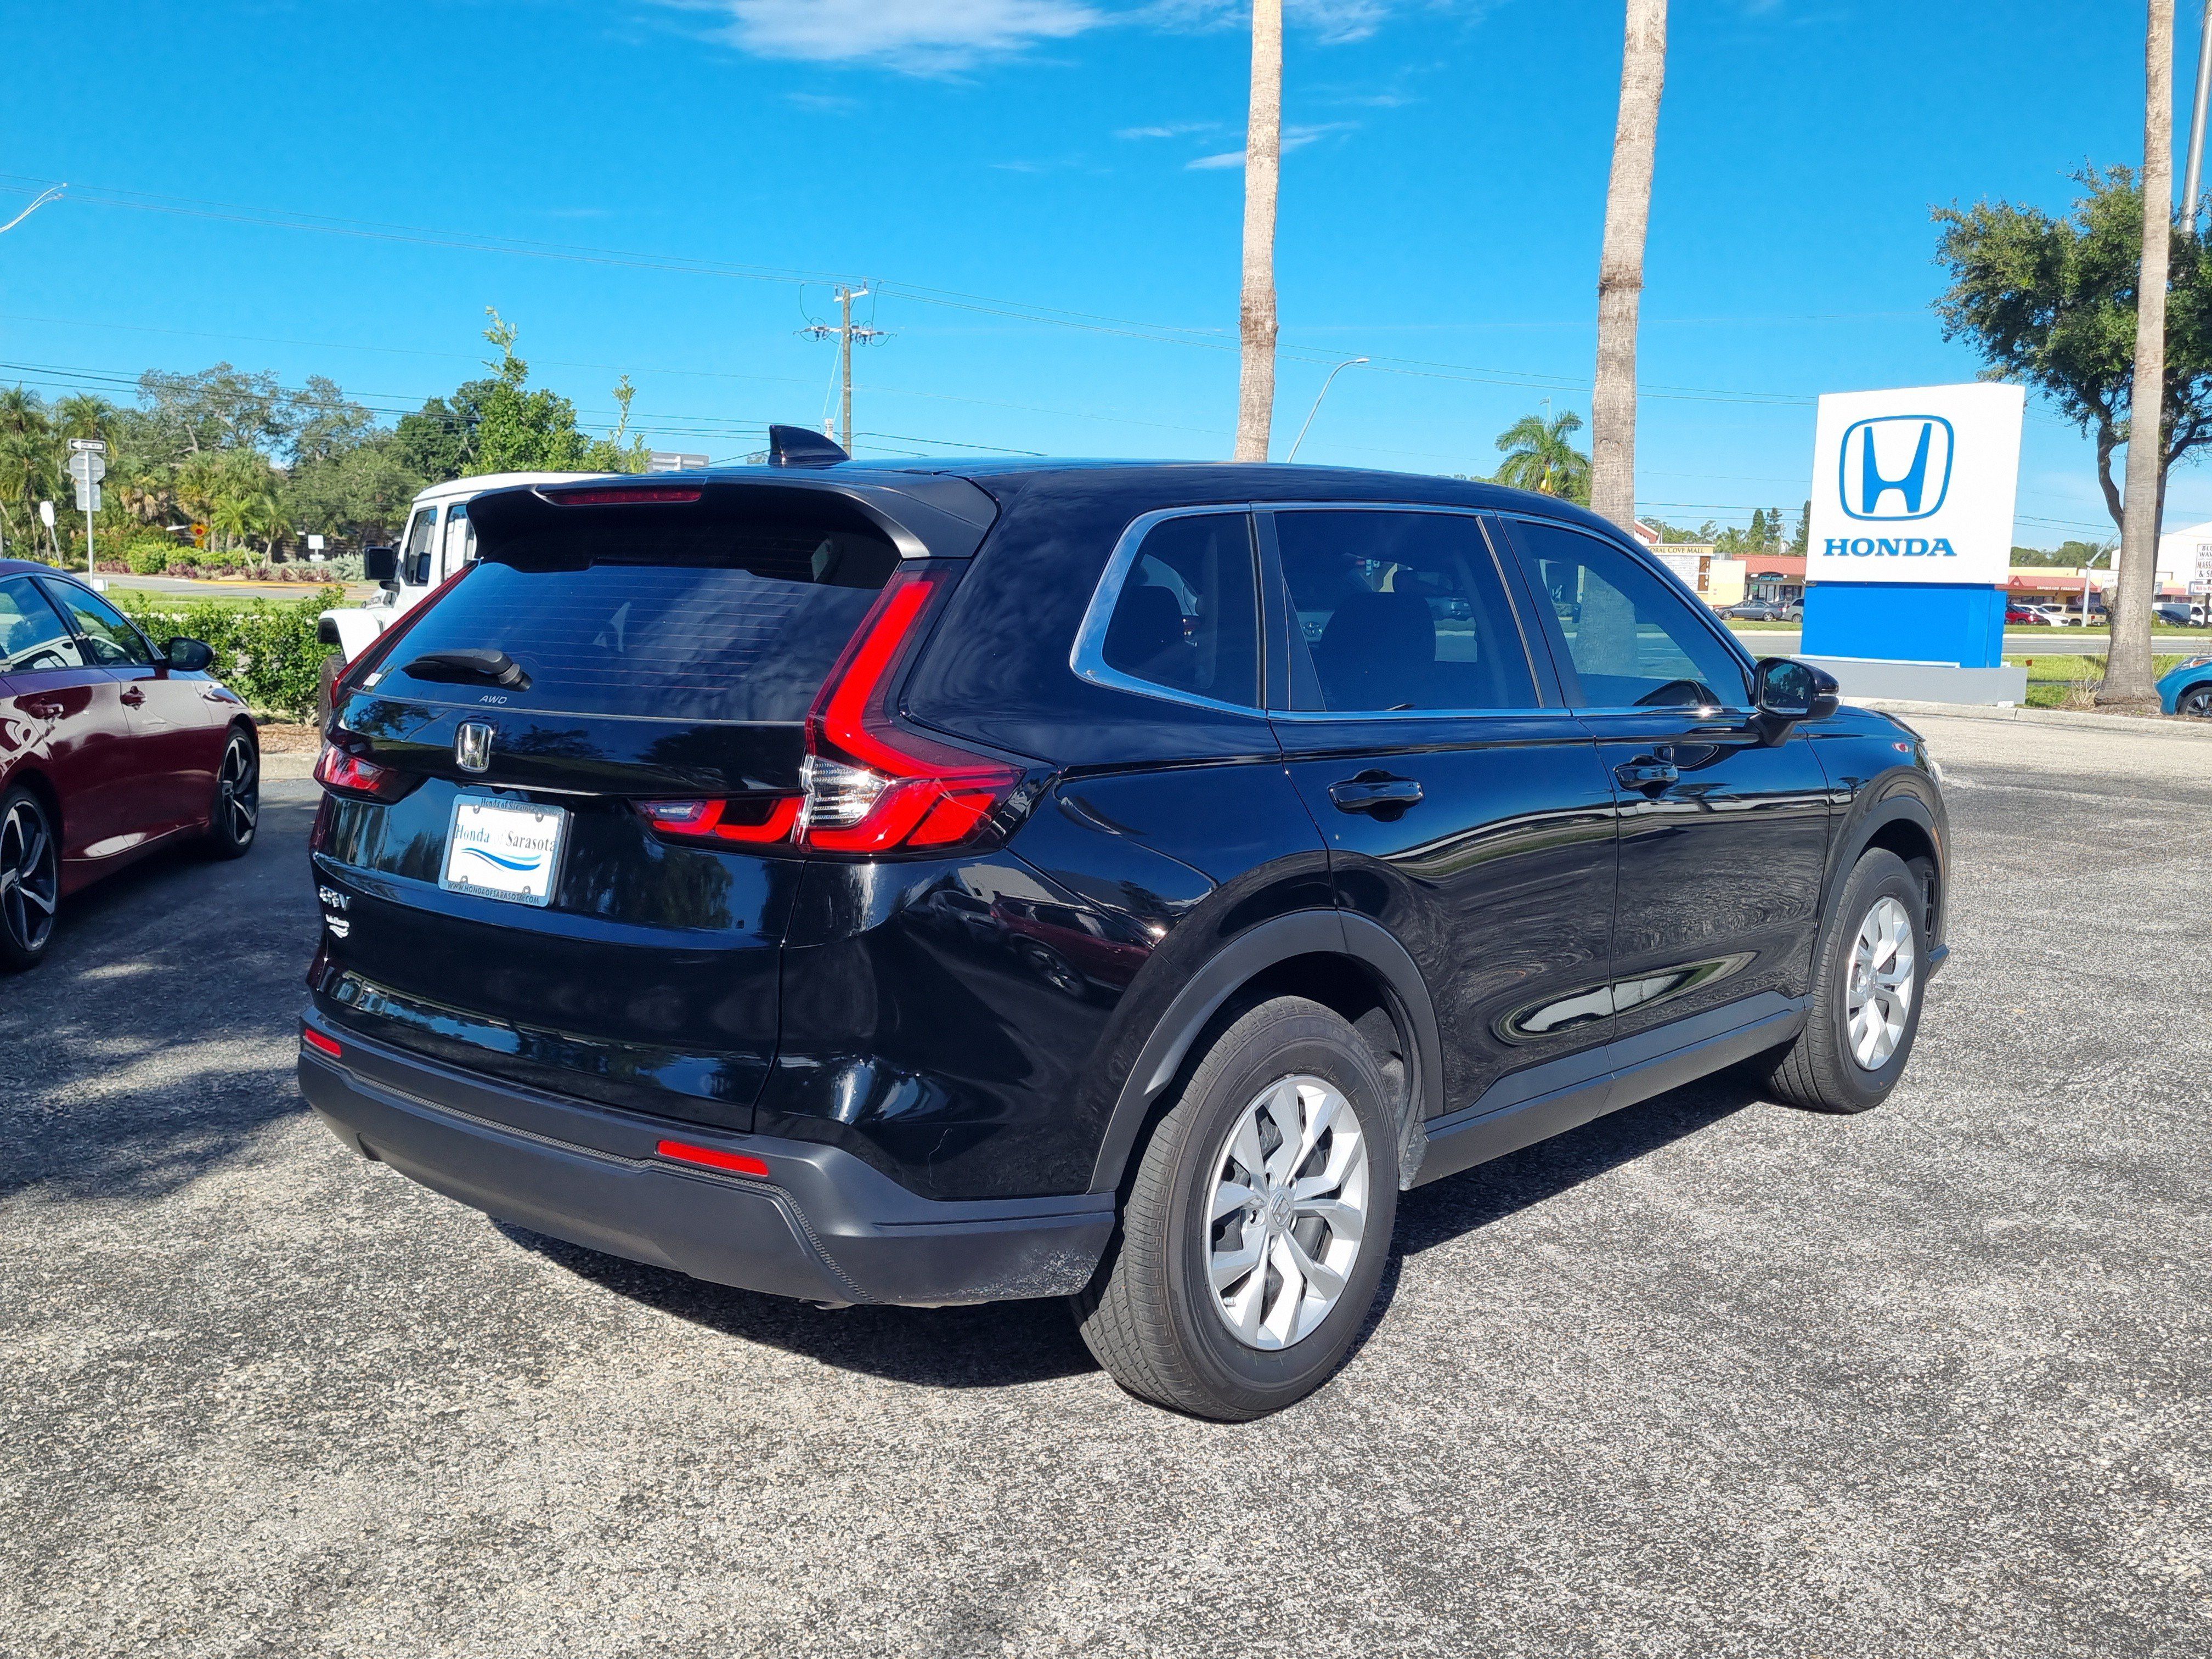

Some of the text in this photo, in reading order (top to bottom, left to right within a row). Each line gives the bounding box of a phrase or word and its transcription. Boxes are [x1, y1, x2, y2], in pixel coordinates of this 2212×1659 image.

[1822, 538, 1957, 557] HONDA
[479, 695, 507, 704] AWD
[481, 798, 500, 808] Honda
[455, 824, 490, 843] Honda
[506, 830, 556, 851] Sarasota
